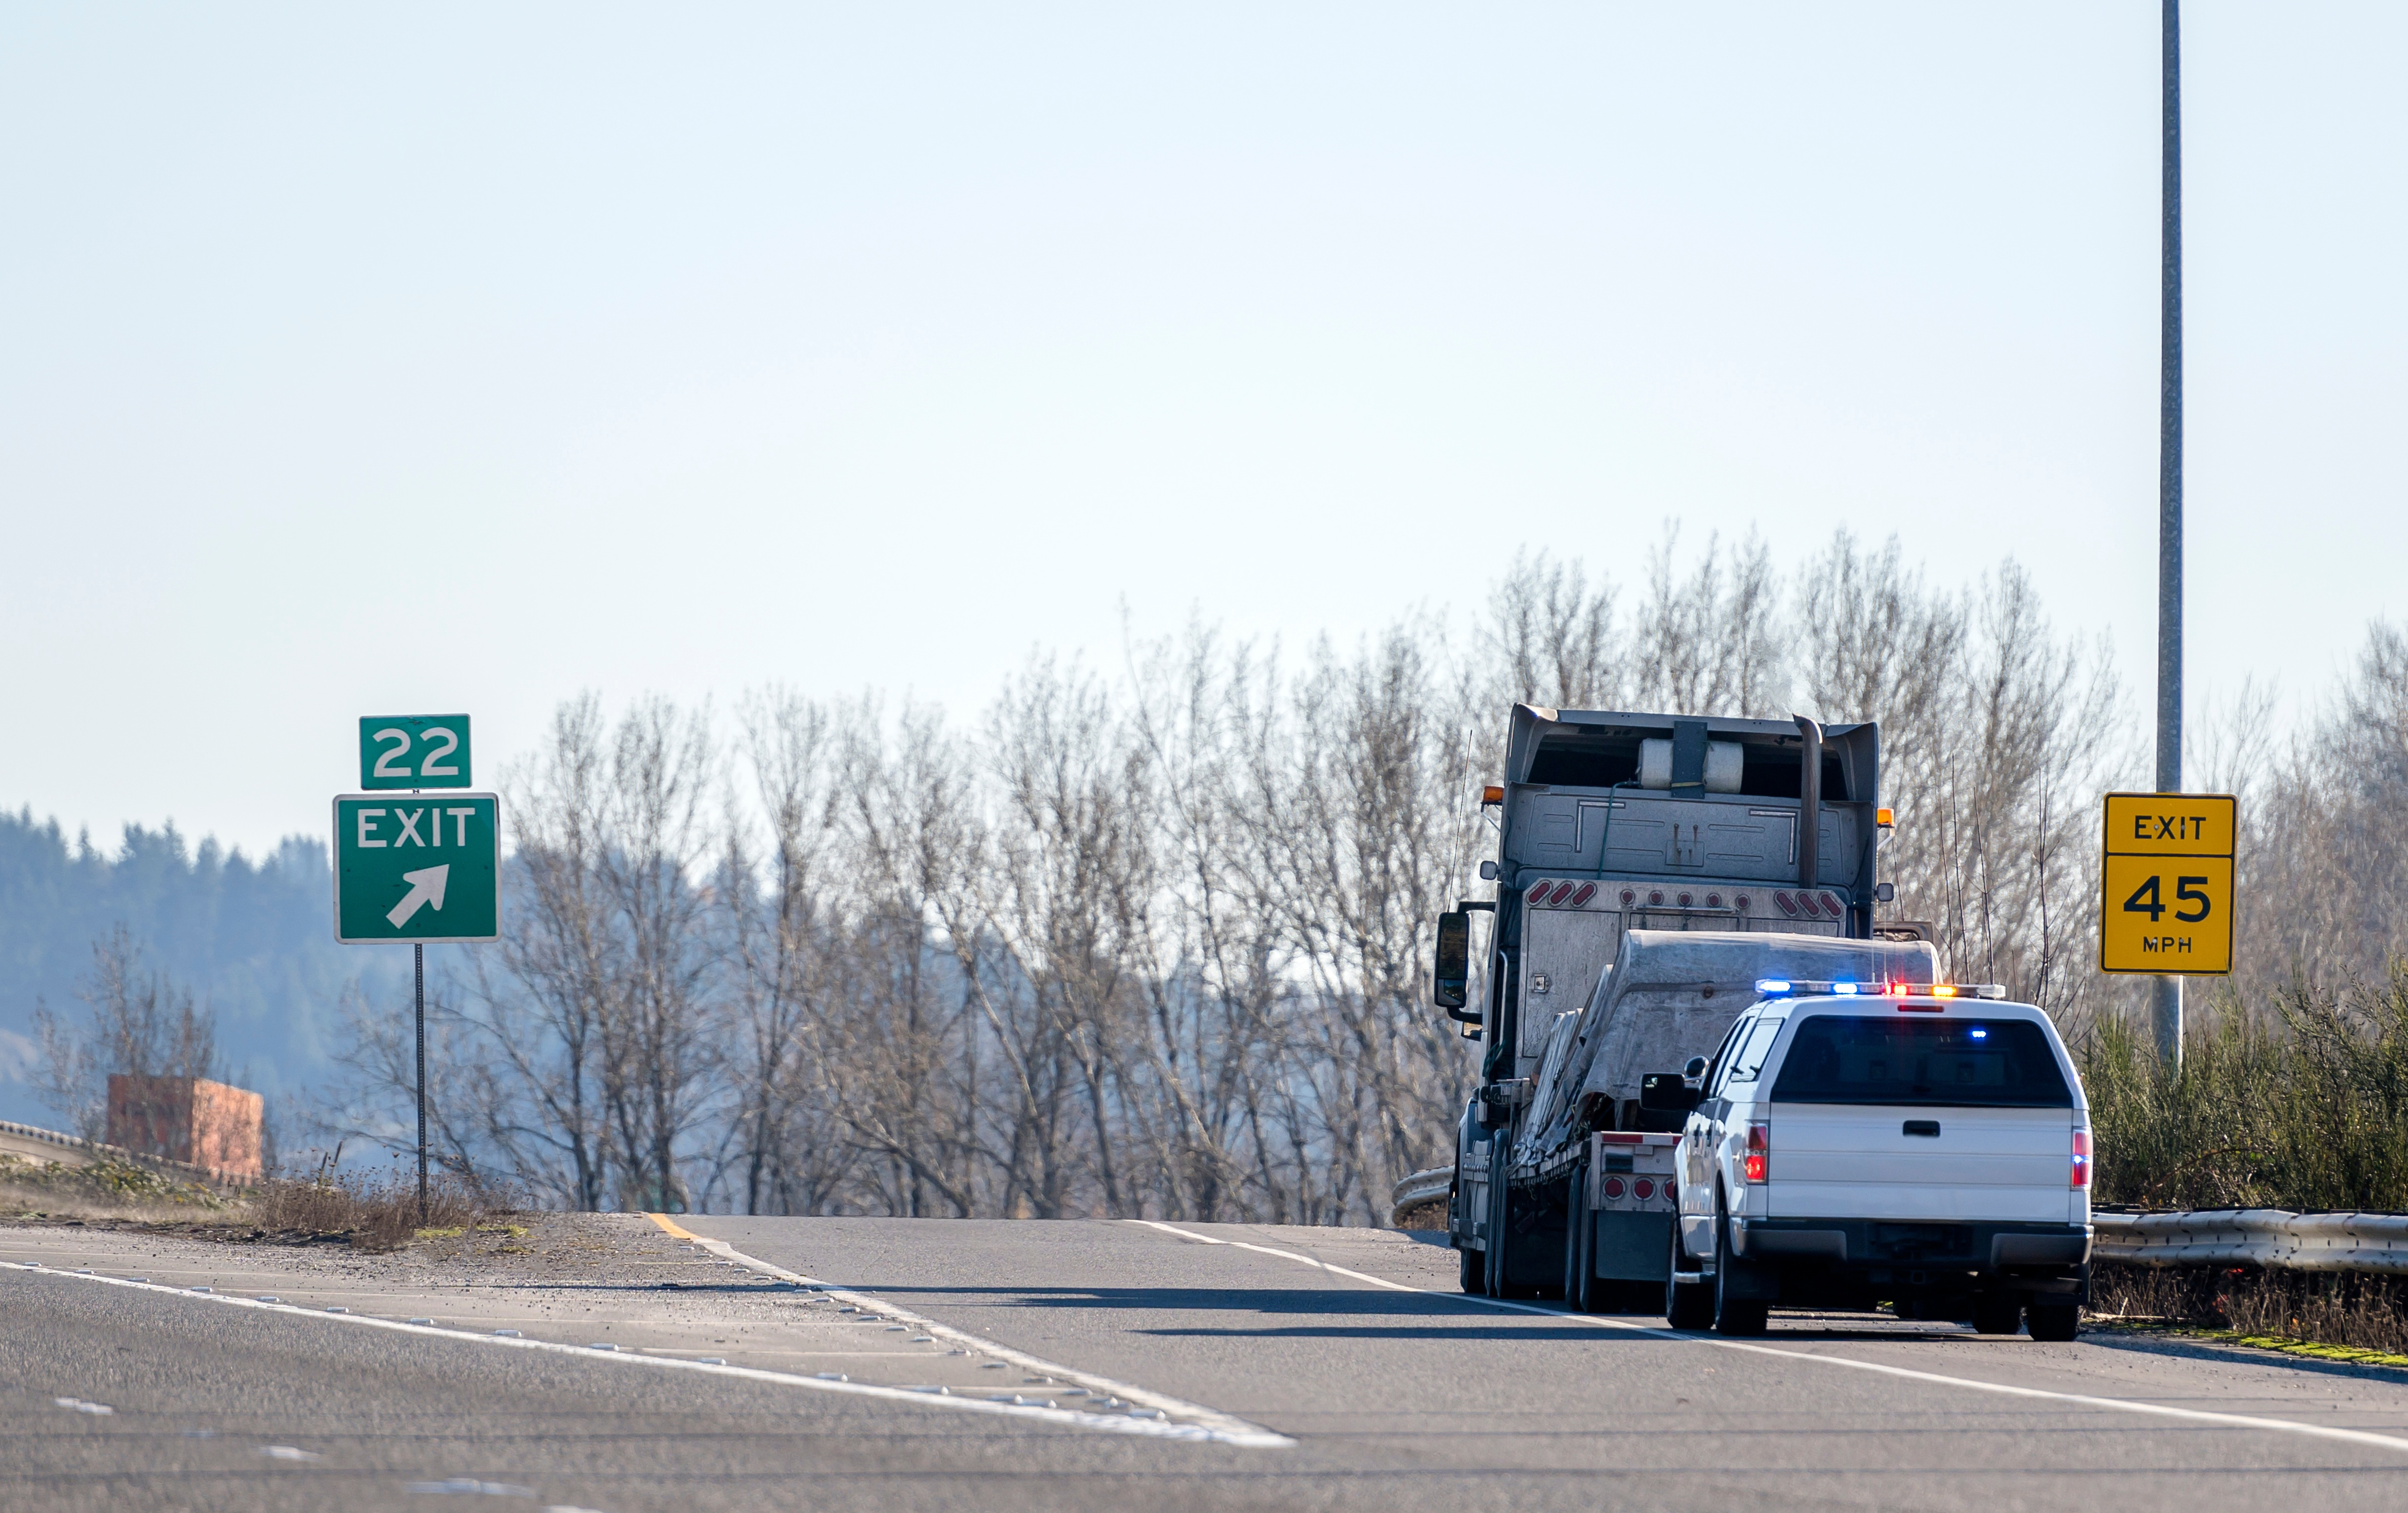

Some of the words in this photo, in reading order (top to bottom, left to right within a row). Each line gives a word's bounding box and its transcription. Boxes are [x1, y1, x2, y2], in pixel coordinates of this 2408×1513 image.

[372, 727, 459, 777] 22
[357, 807, 476, 847] EXIT
[2135, 815, 2206, 840] EXIT
[2123, 875, 2211, 923] 45
[2143, 936, 2191, 953] MPH
